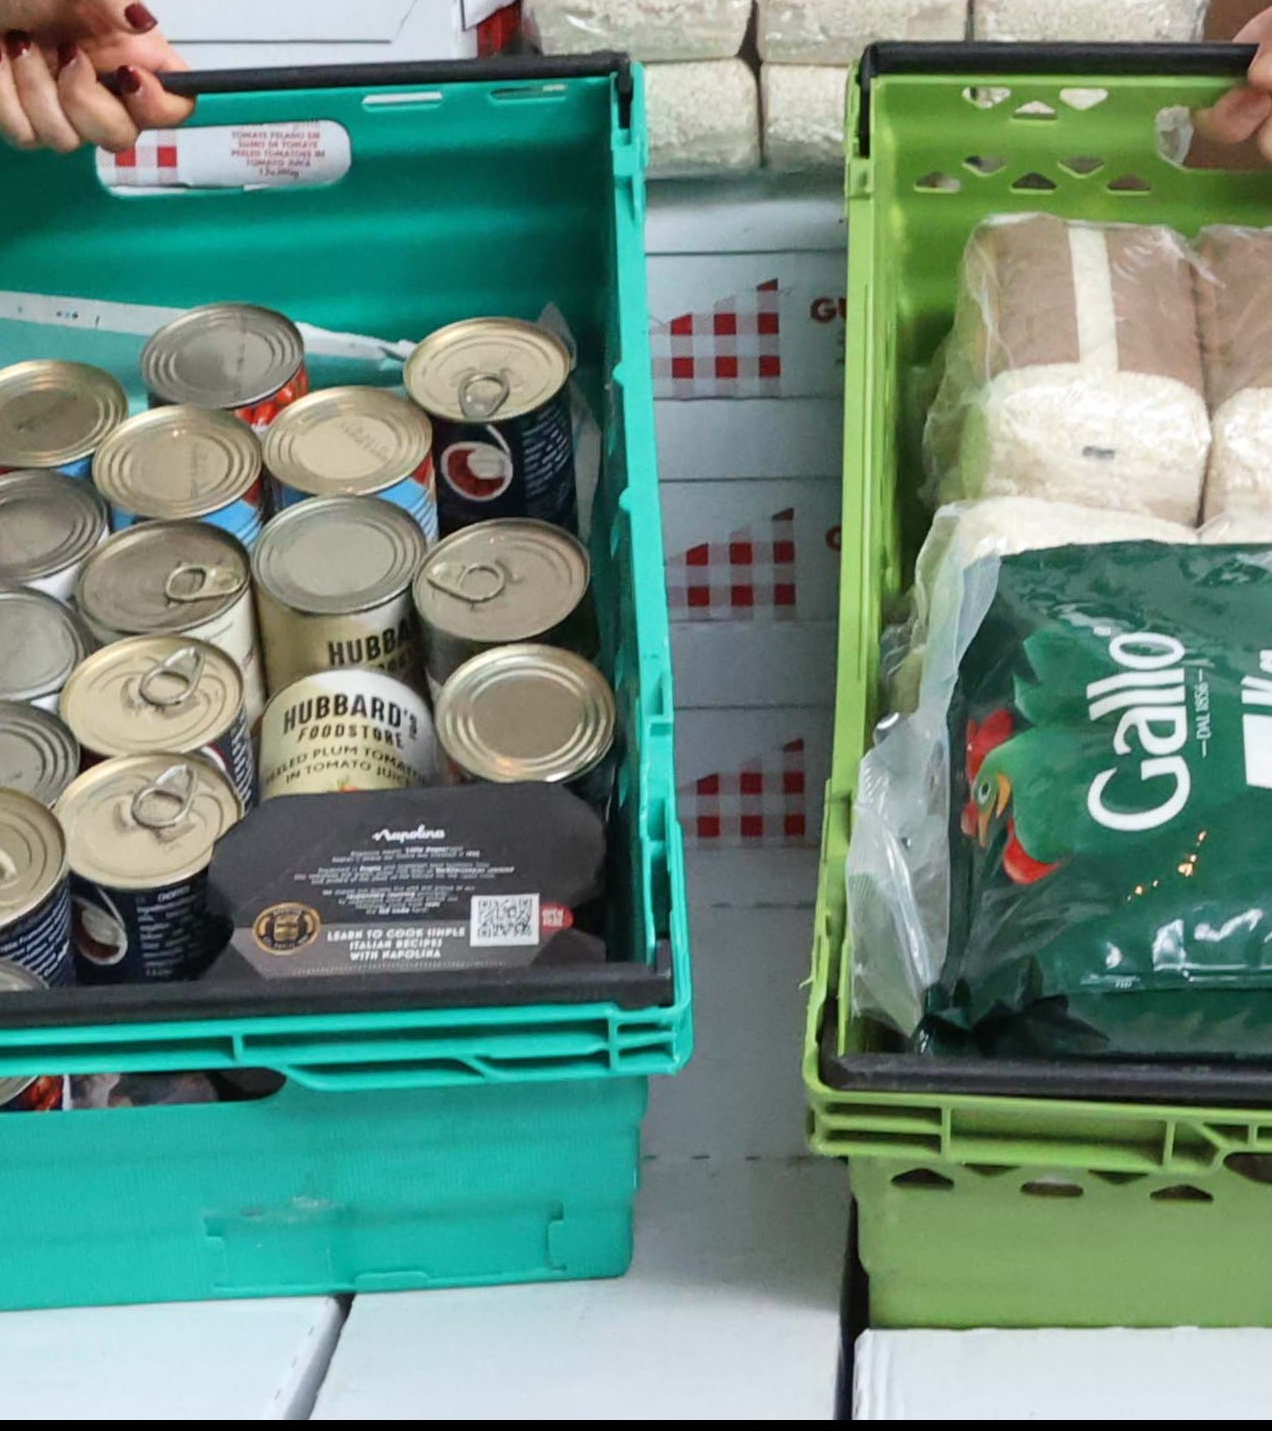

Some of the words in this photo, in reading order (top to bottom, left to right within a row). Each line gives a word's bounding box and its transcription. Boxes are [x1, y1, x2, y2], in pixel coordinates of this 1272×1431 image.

[283, 693, 418, 741] HUBBARD'S
[1195, 711, 1212, 741] DAL
[297, 723, 404, 751] FOODSTORE
[1085, 632, 1191, 832] Gallo
[313, 745, 358, 758] PLUM
[285, 771, 301, 784] IN
[305, 760, 372, 774] TOMATO
[372, 824, 446, 844] Napolina
[327, 930, 364, 942] LEARN
[366, 929, 383, 940] TO
[385, 929, 425, 939] COOK
[427, 927, 466, 938] SIMPLE
[349, 940, 393, 951] ITALIAN
[395, 938, 443, 949] RECIPES
[349, 950, 379, 961] WITH
[381, 949, 441, 960] NAPOLINA
